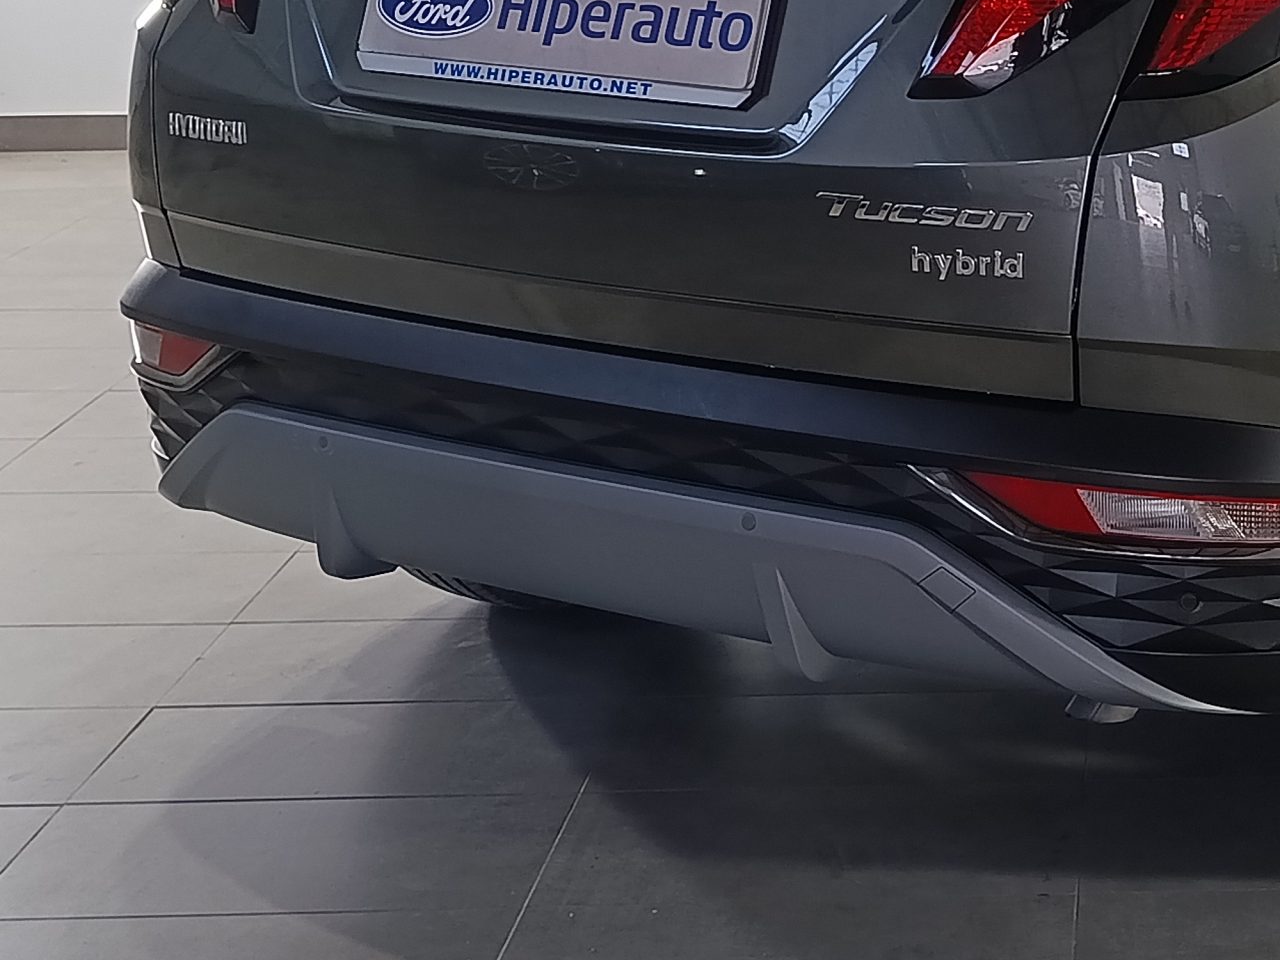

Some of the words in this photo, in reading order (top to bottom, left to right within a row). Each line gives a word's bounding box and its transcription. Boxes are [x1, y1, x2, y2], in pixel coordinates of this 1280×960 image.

[433, 61, 654, 98] WWW.HIPERAUTO.NET
[168, 112, 248, 145] HYUNDAI
[910, 245, 1025, 282] hybrid
